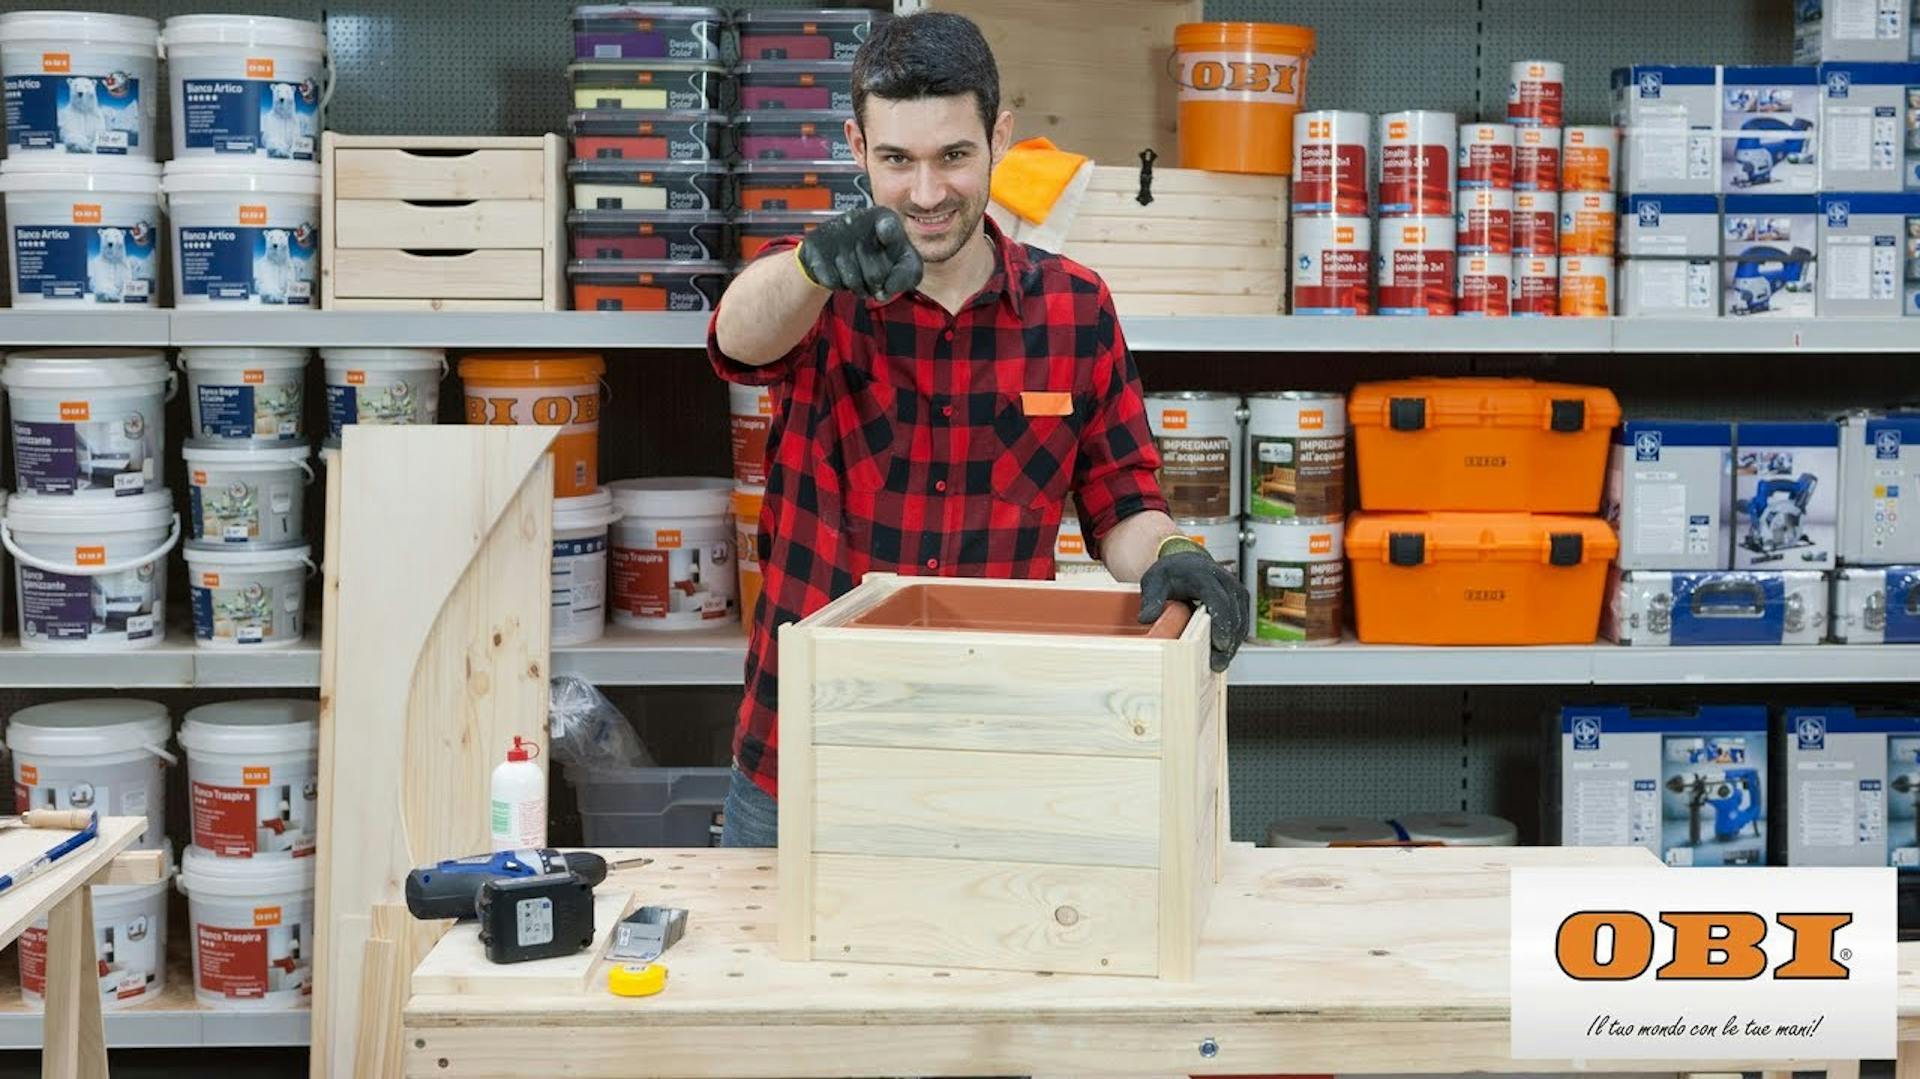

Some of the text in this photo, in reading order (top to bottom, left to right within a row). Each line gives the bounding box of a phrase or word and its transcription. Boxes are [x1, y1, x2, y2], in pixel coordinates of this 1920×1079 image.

[669, 39, 699, 49] Design
[669, 48, 692, 57] Color
[1192, 61, 1297, 94] OBI
[214, 83, 243, 93] Artico
[670, 91, 699, 101] Design
[670, 141, 700, 150] Design
[670, 191, 699, 201] Design
[41, 229, 70, 240] Artico
[207, 230, 236, 241] Artico
[670, 242, 699, 253] Design
[670, 292, 699, 303] Design
[630, 553, 663, 565] Traspira
[213, 789, 251, 803] Traspira
[222, 931, 262, 945] Traspira
